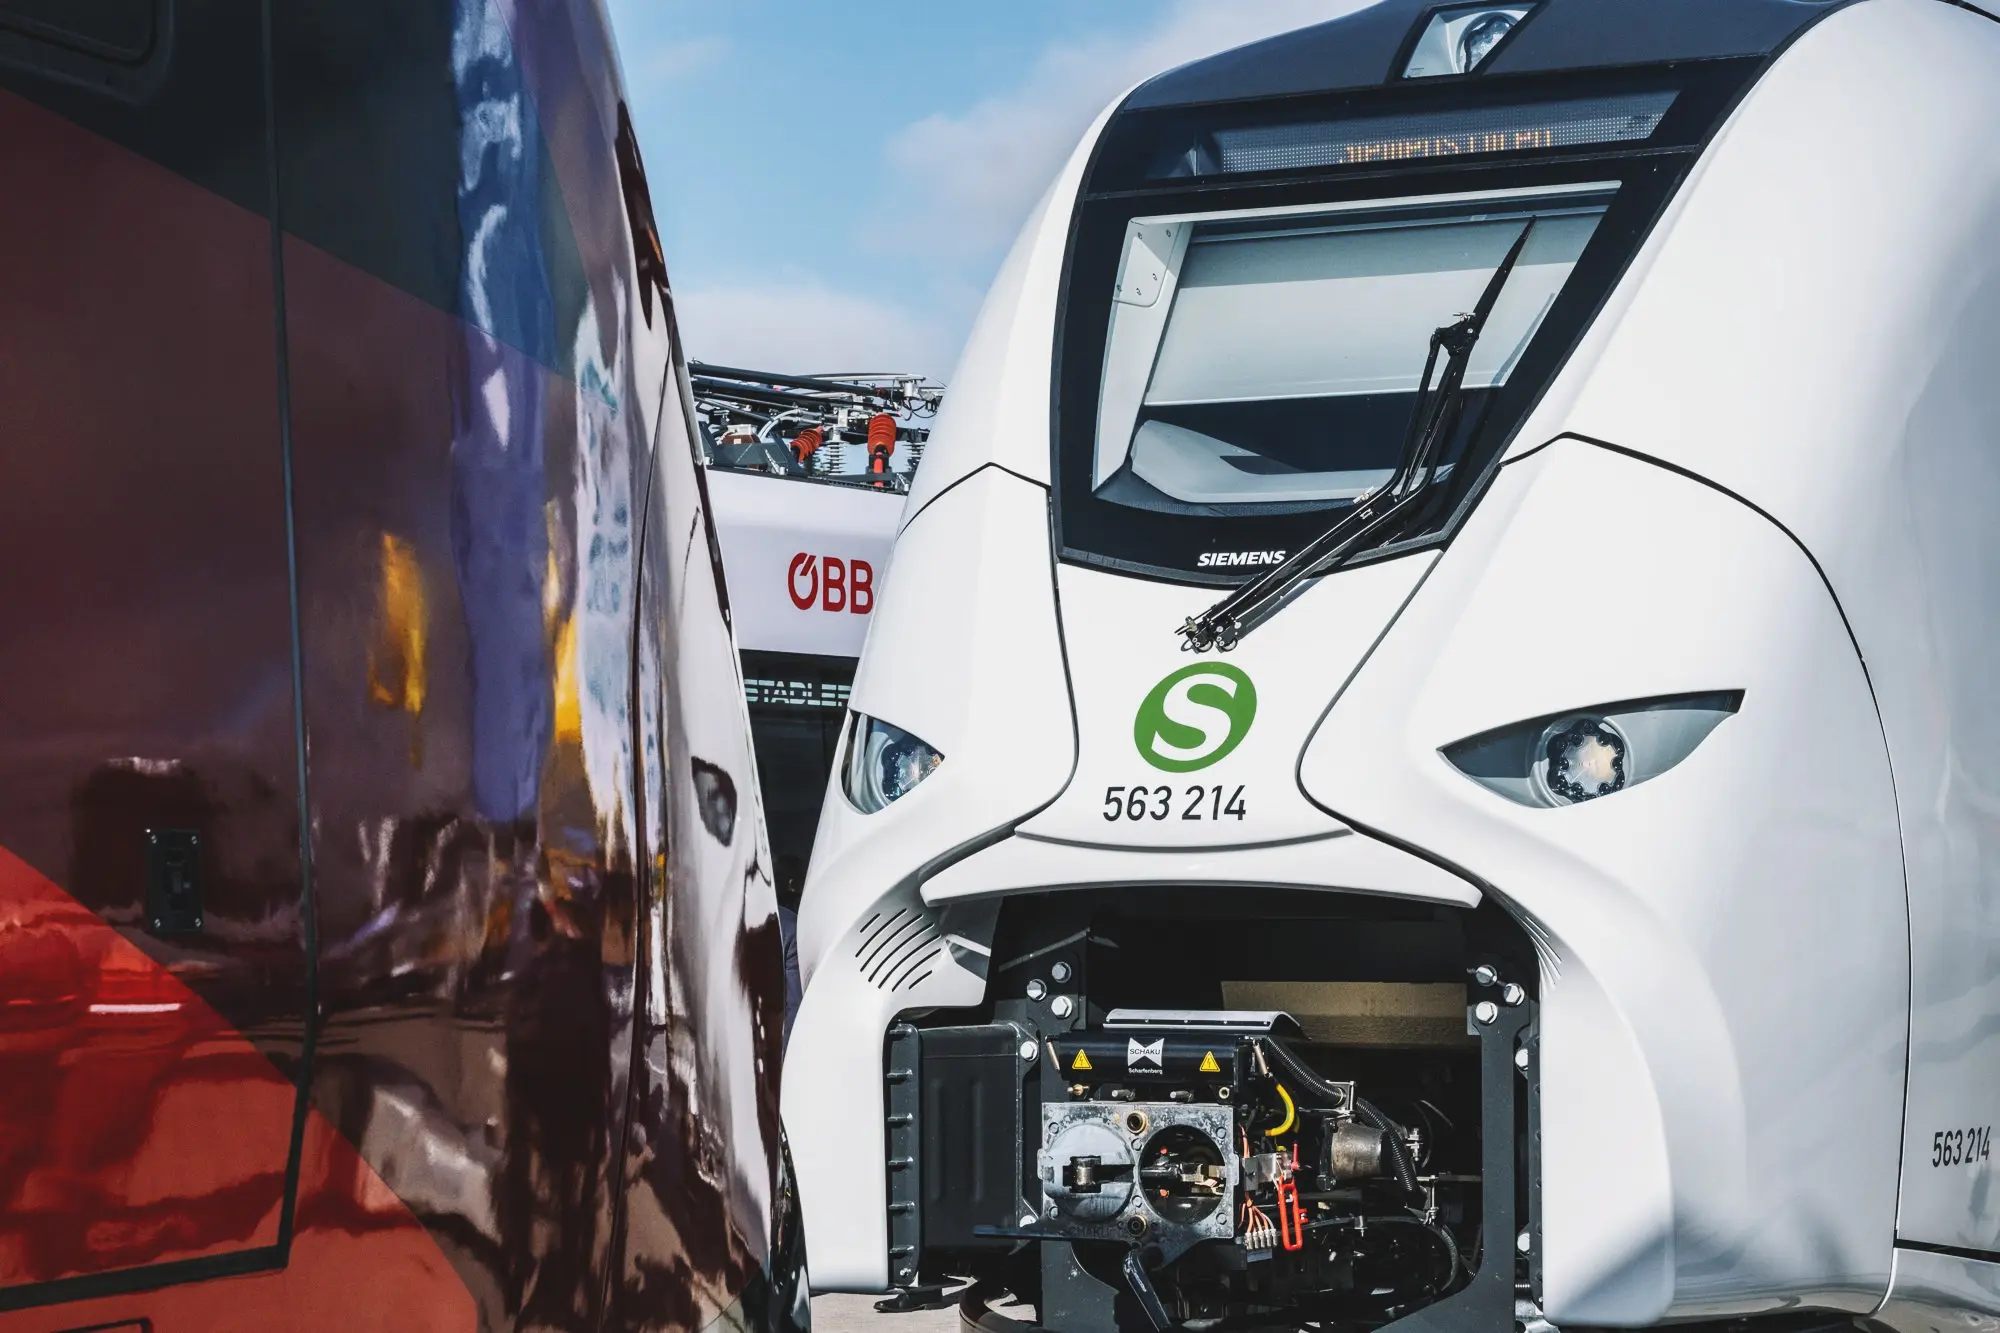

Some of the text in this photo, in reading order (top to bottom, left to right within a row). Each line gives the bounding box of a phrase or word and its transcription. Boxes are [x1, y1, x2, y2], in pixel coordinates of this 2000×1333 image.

[1197, 550, 1287, 567] SIEMENS
[743, 679, 852, 707] STADLER
[1150, 672, 1238, 762] S
[1103, 785, 1247, 822] 563 214
[1128, 1067, 1163, 1075] Scharfenberg
[1932, 1125, 1991, 1168] 563 214
